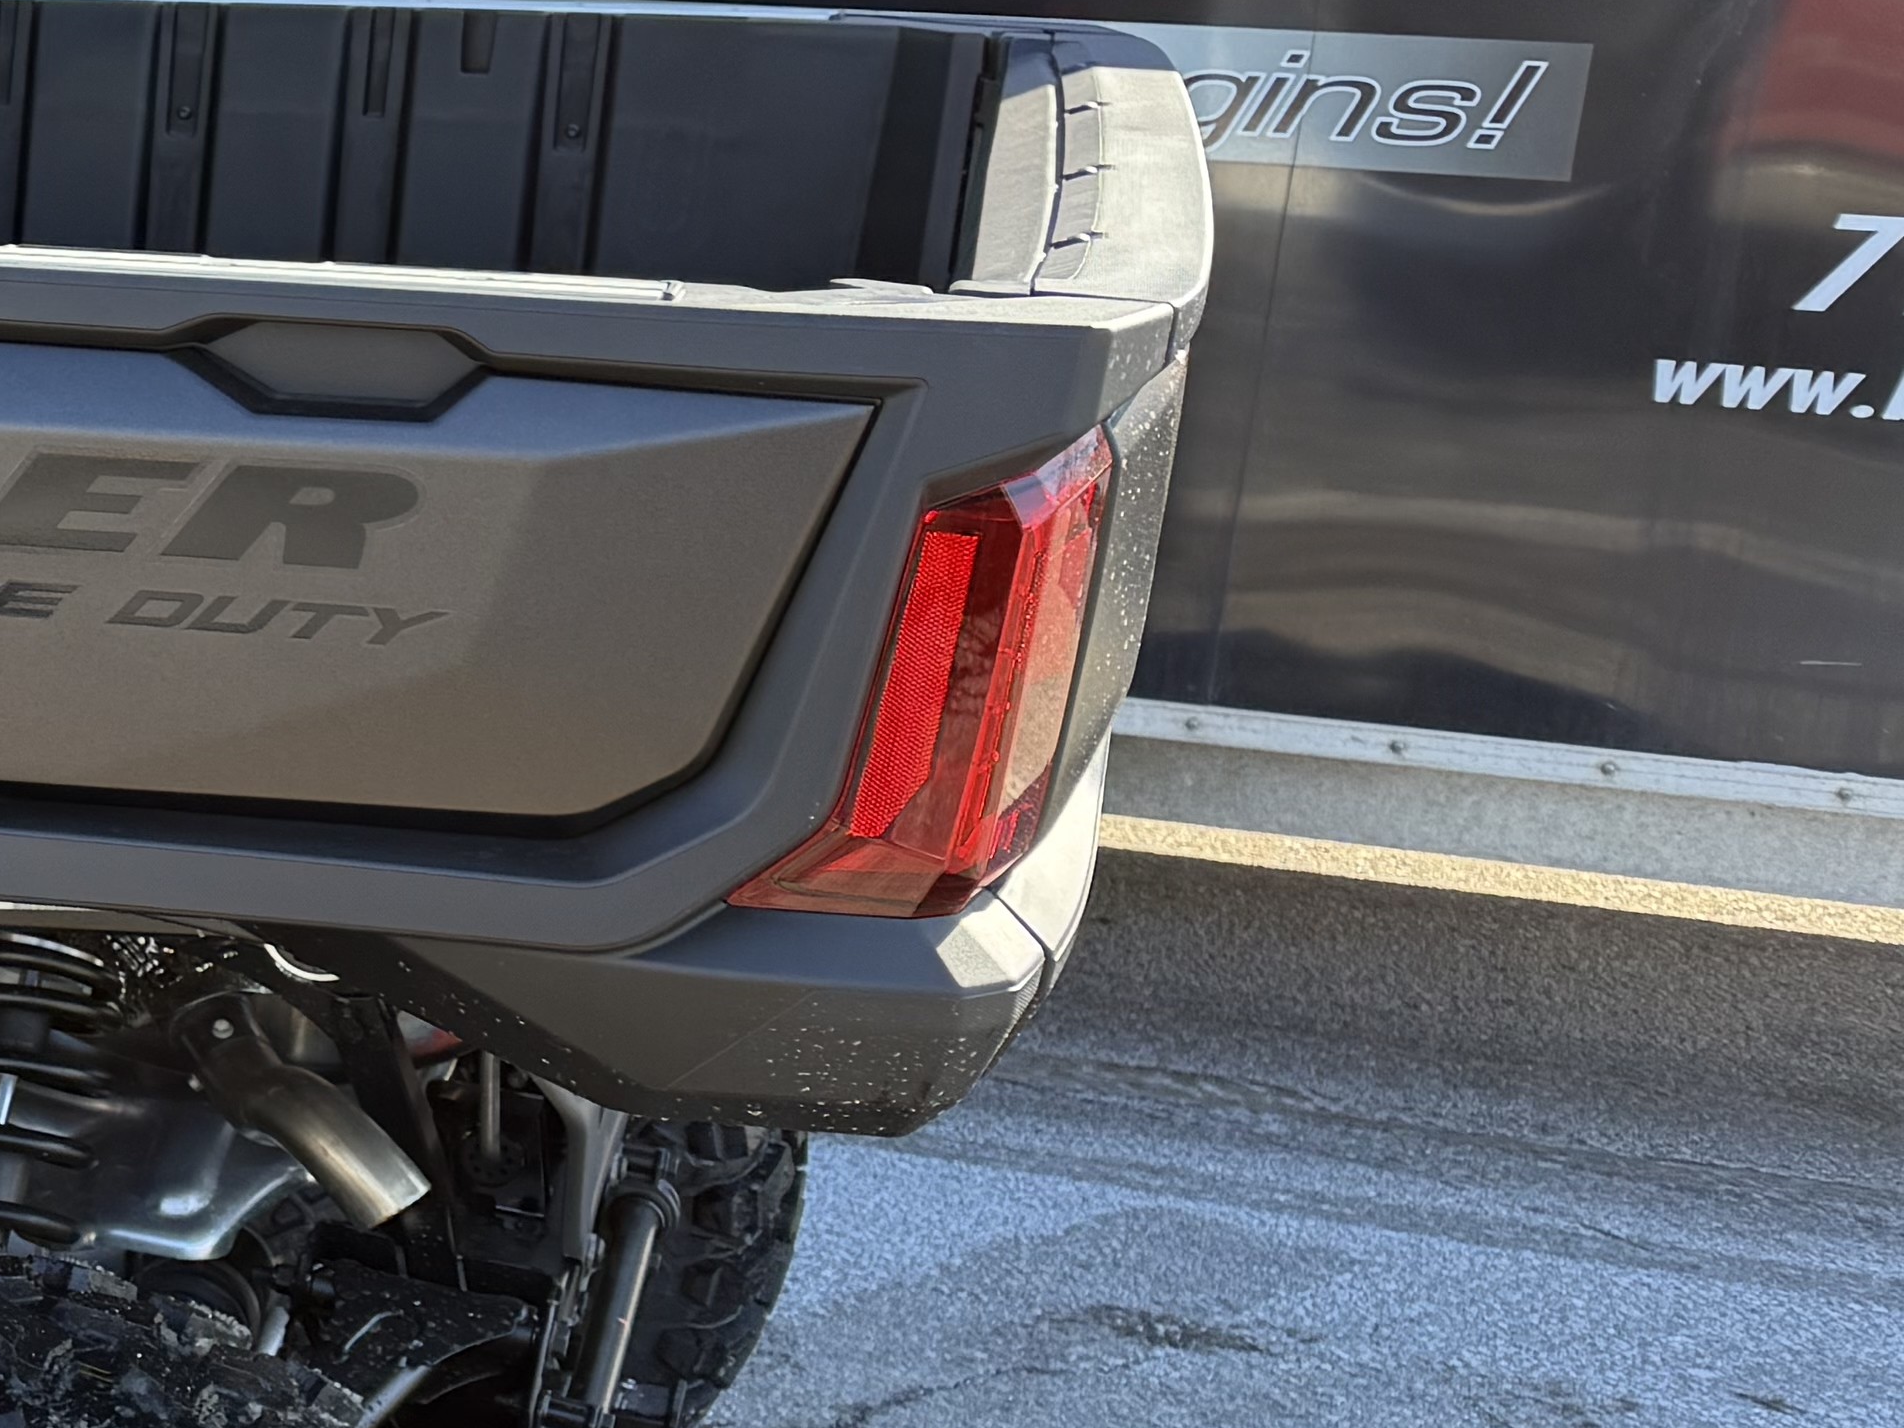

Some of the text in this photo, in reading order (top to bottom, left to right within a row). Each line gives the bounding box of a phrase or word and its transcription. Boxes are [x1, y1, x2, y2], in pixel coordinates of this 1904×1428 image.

[1183, 49, 1549, 153] gins!
[1653, 358, 1904, 421] www.
[104, 587, 452, 649] DUTY
